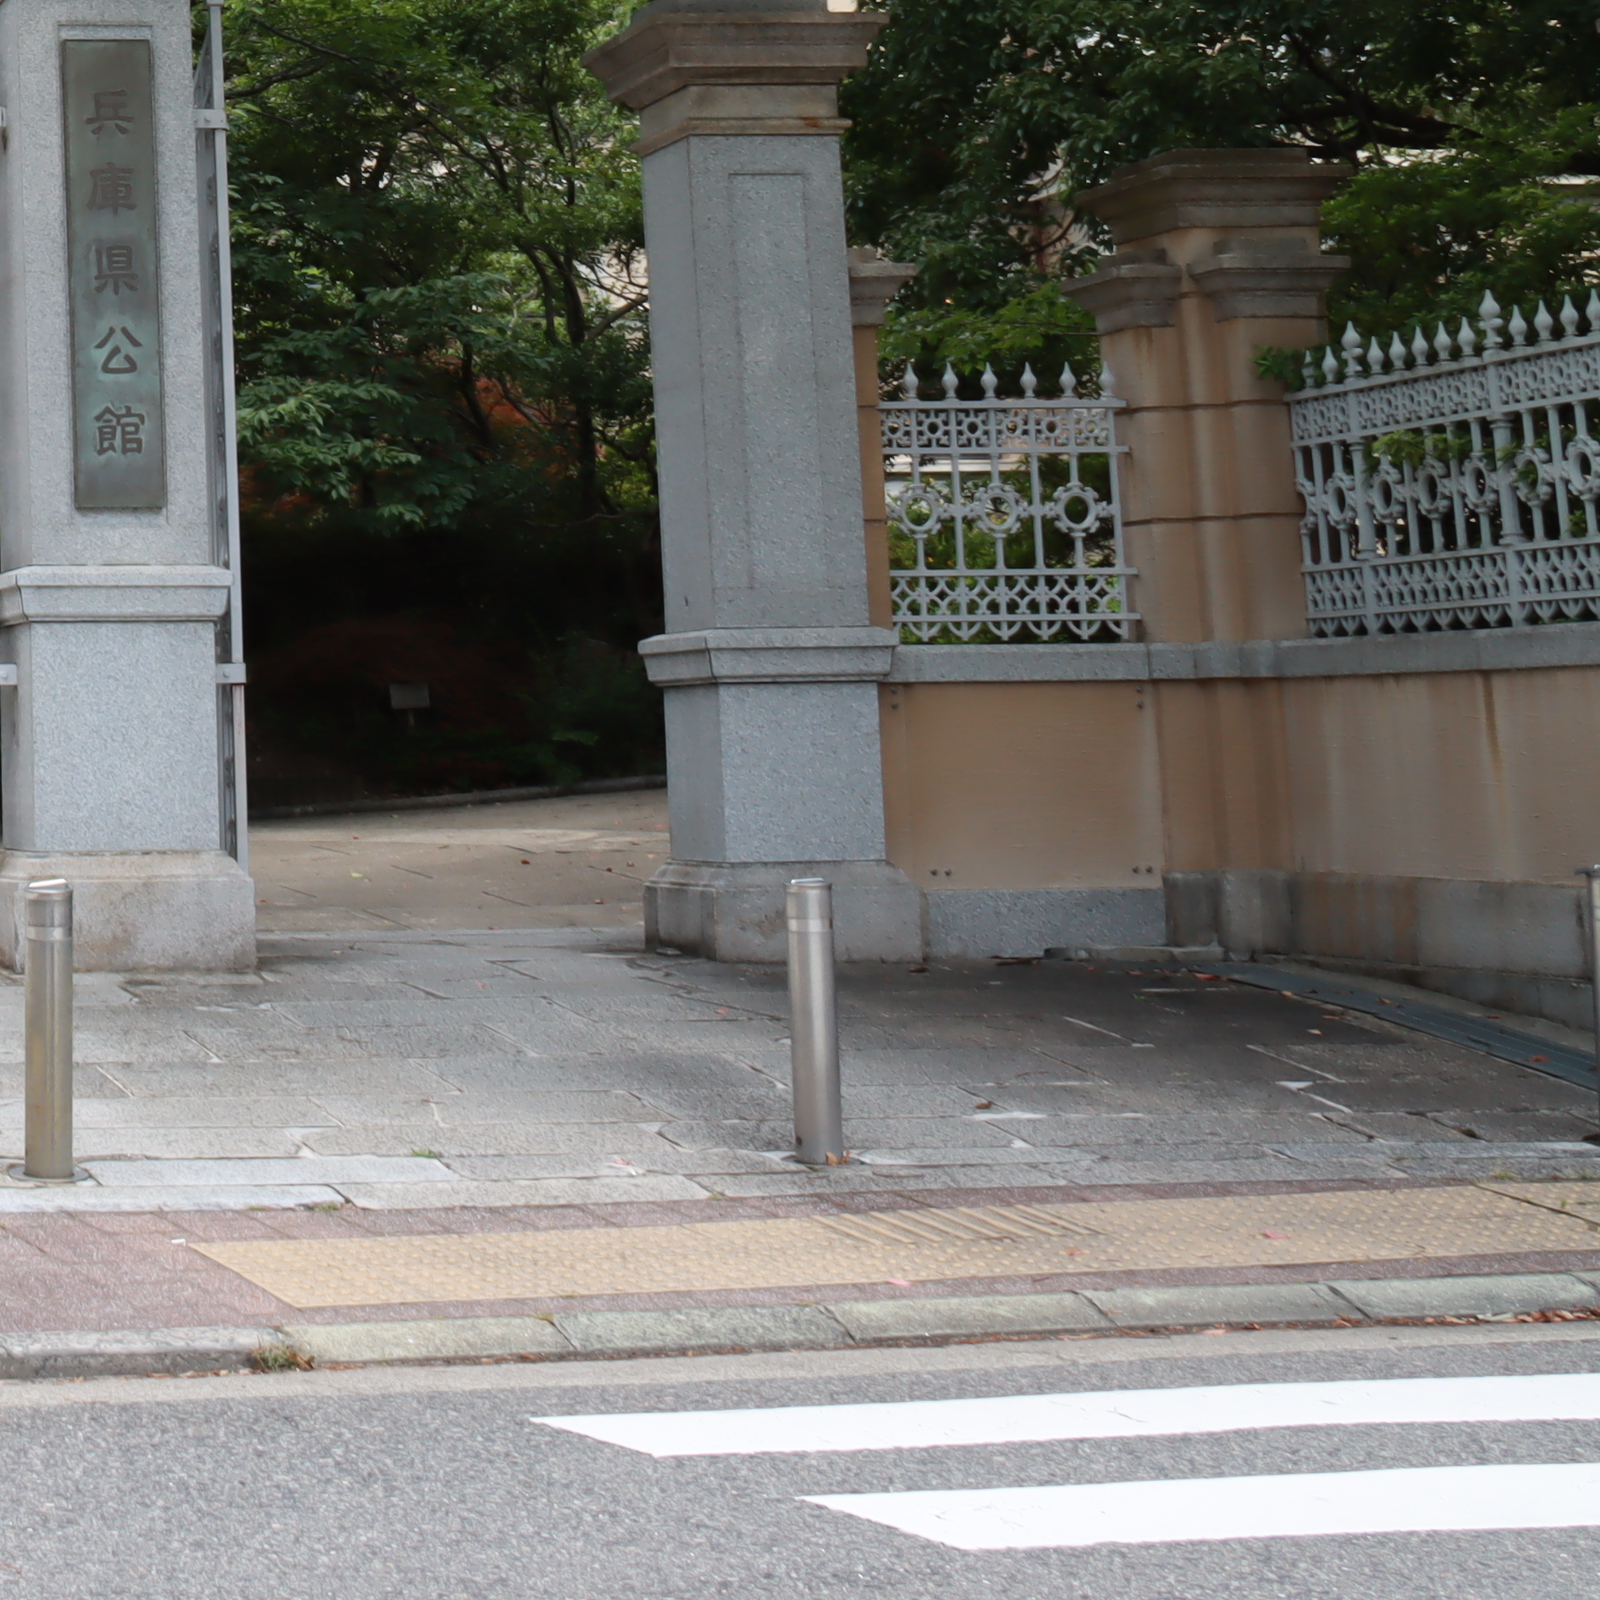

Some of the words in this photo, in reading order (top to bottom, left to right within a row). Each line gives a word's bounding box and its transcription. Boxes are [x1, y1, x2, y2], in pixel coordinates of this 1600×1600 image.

[85, 88, 146, 457] 兵庫県公館
